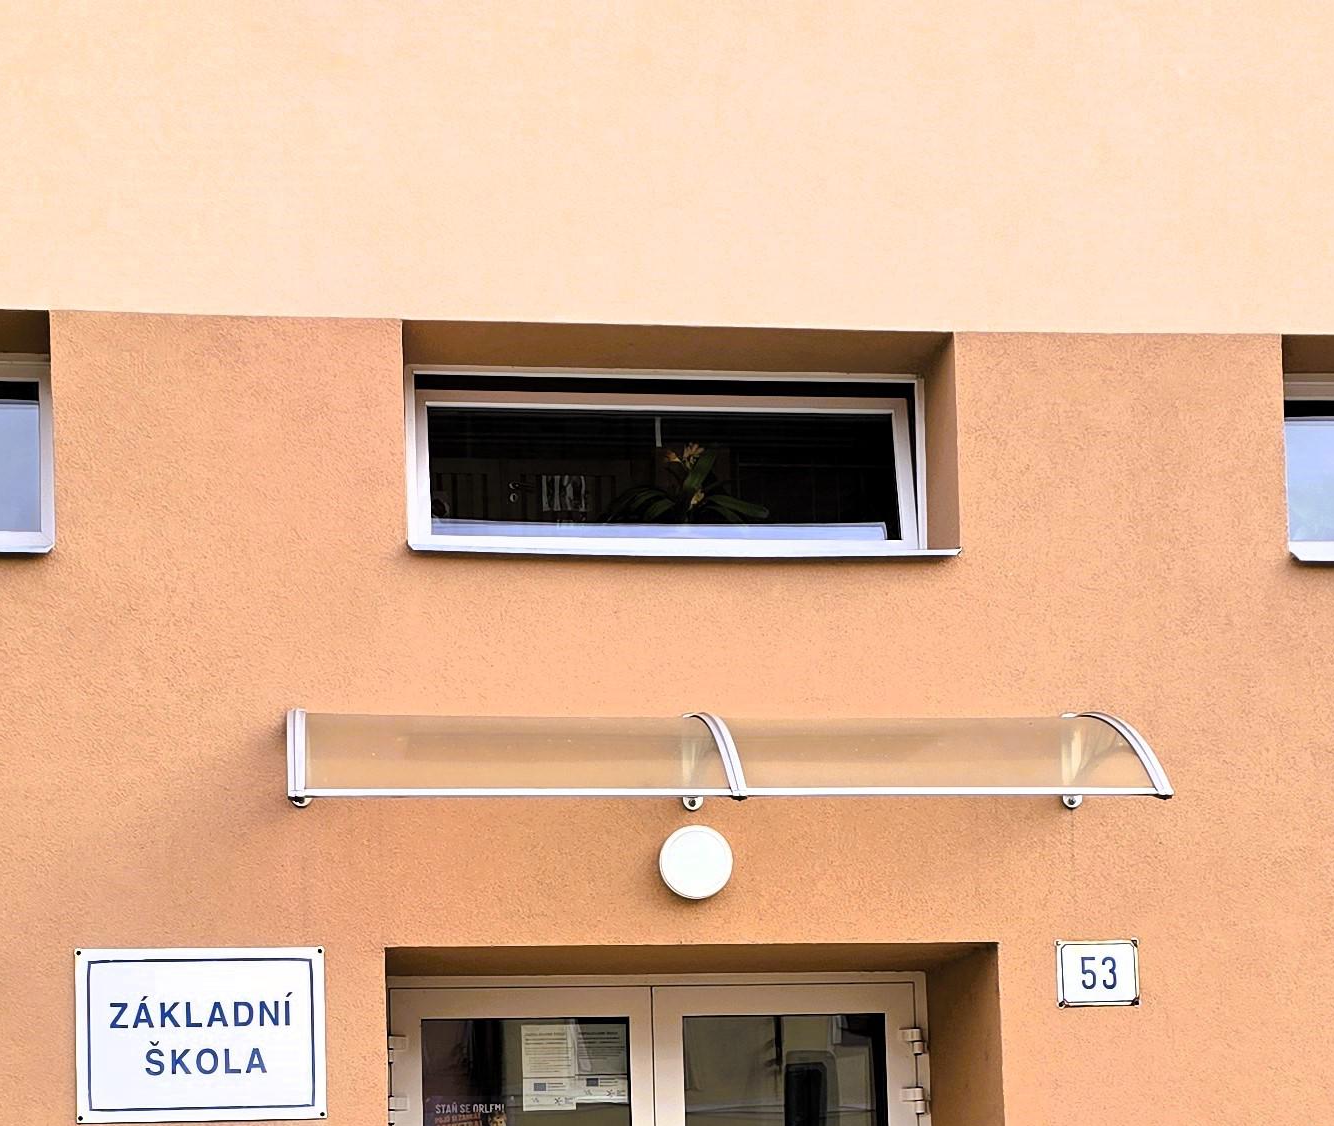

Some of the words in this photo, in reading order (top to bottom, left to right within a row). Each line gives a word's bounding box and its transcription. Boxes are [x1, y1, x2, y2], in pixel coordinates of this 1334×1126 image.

[1080, 956, 1117, 990] 53
[109, 991, 293, 1029] ZÁKLADNÍ
[144, 1040, 268, 1077] ŠKOLA
[435, 1102, 458, 1114] STAŇ
[459, 1104, 471, 1114] SE
